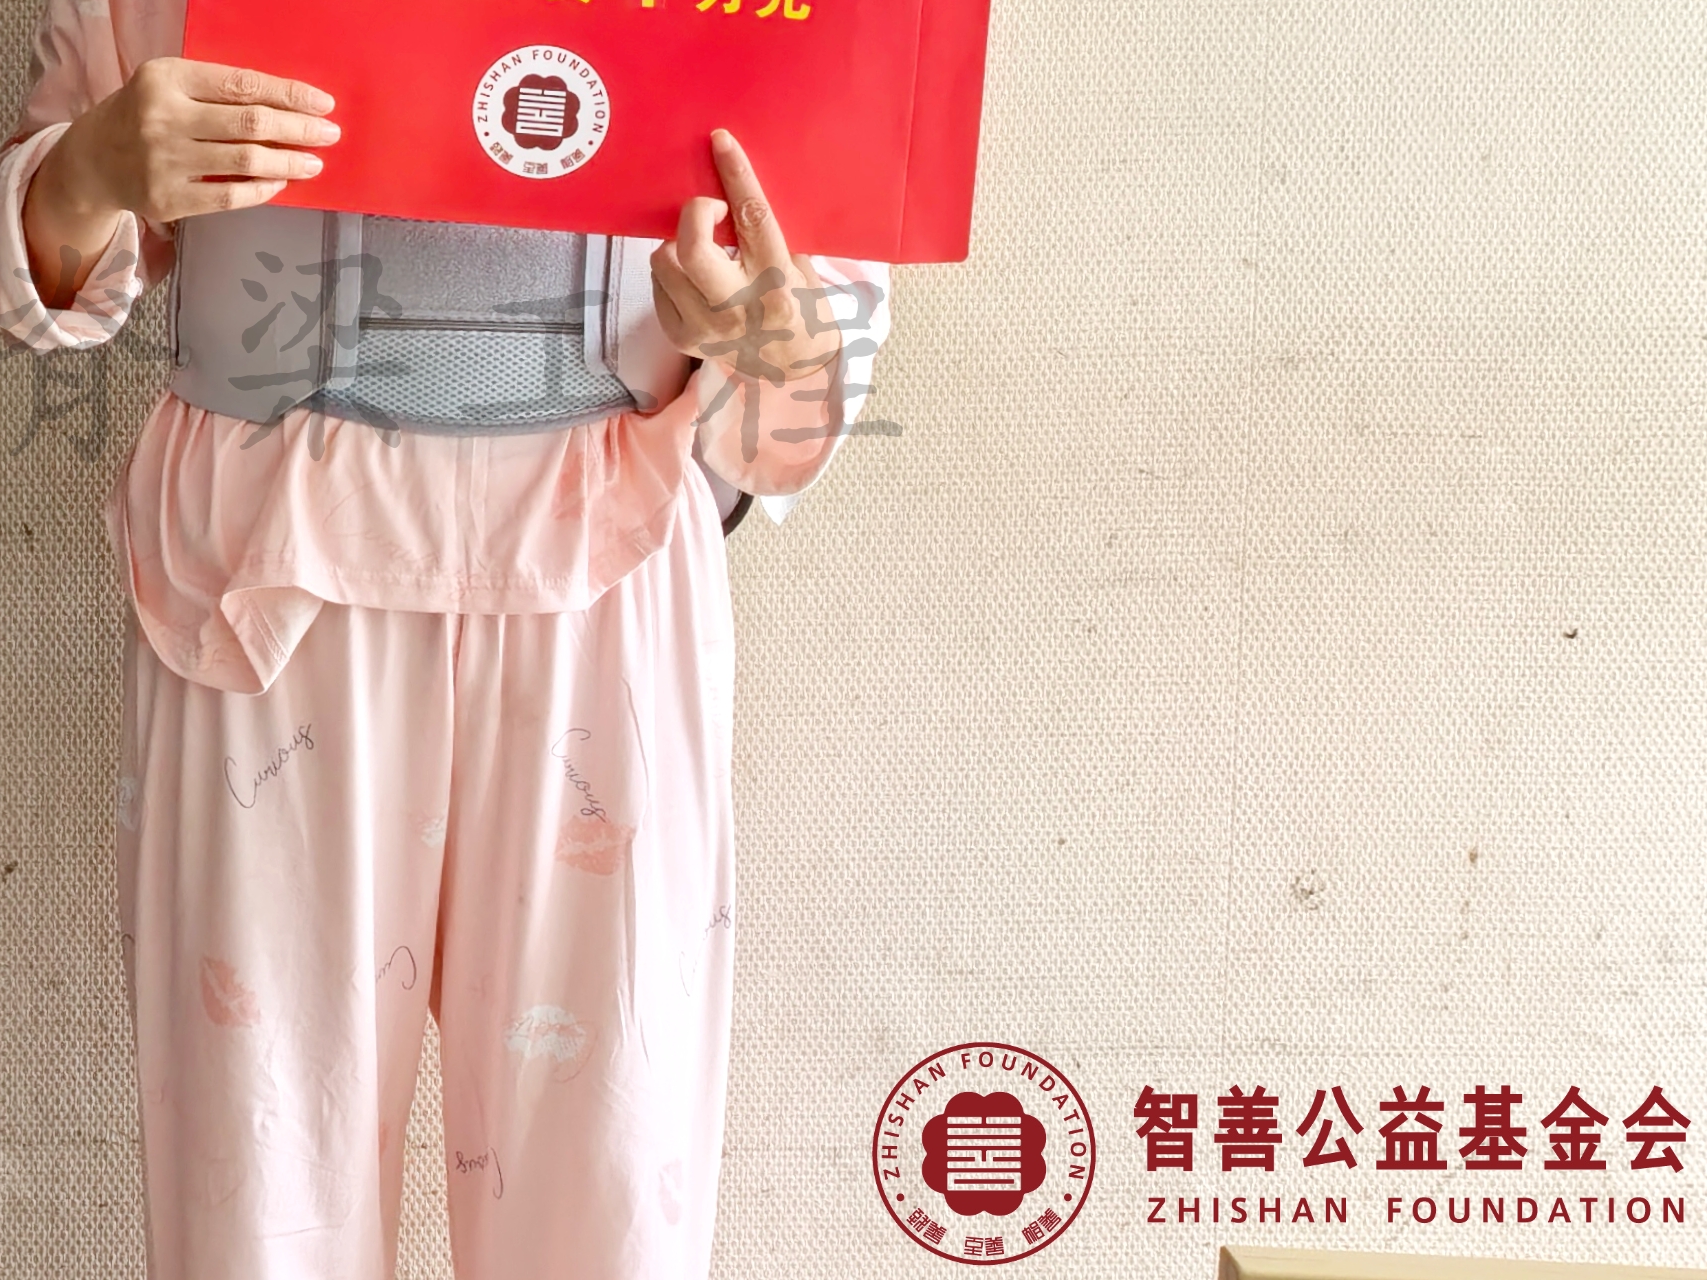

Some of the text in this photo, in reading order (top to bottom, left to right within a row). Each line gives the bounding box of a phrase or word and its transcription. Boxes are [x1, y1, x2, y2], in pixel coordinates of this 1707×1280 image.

[477, 49, 606, 133] ZHISHAN FOUNDATION
[223, 723, 315, 809] Curious
